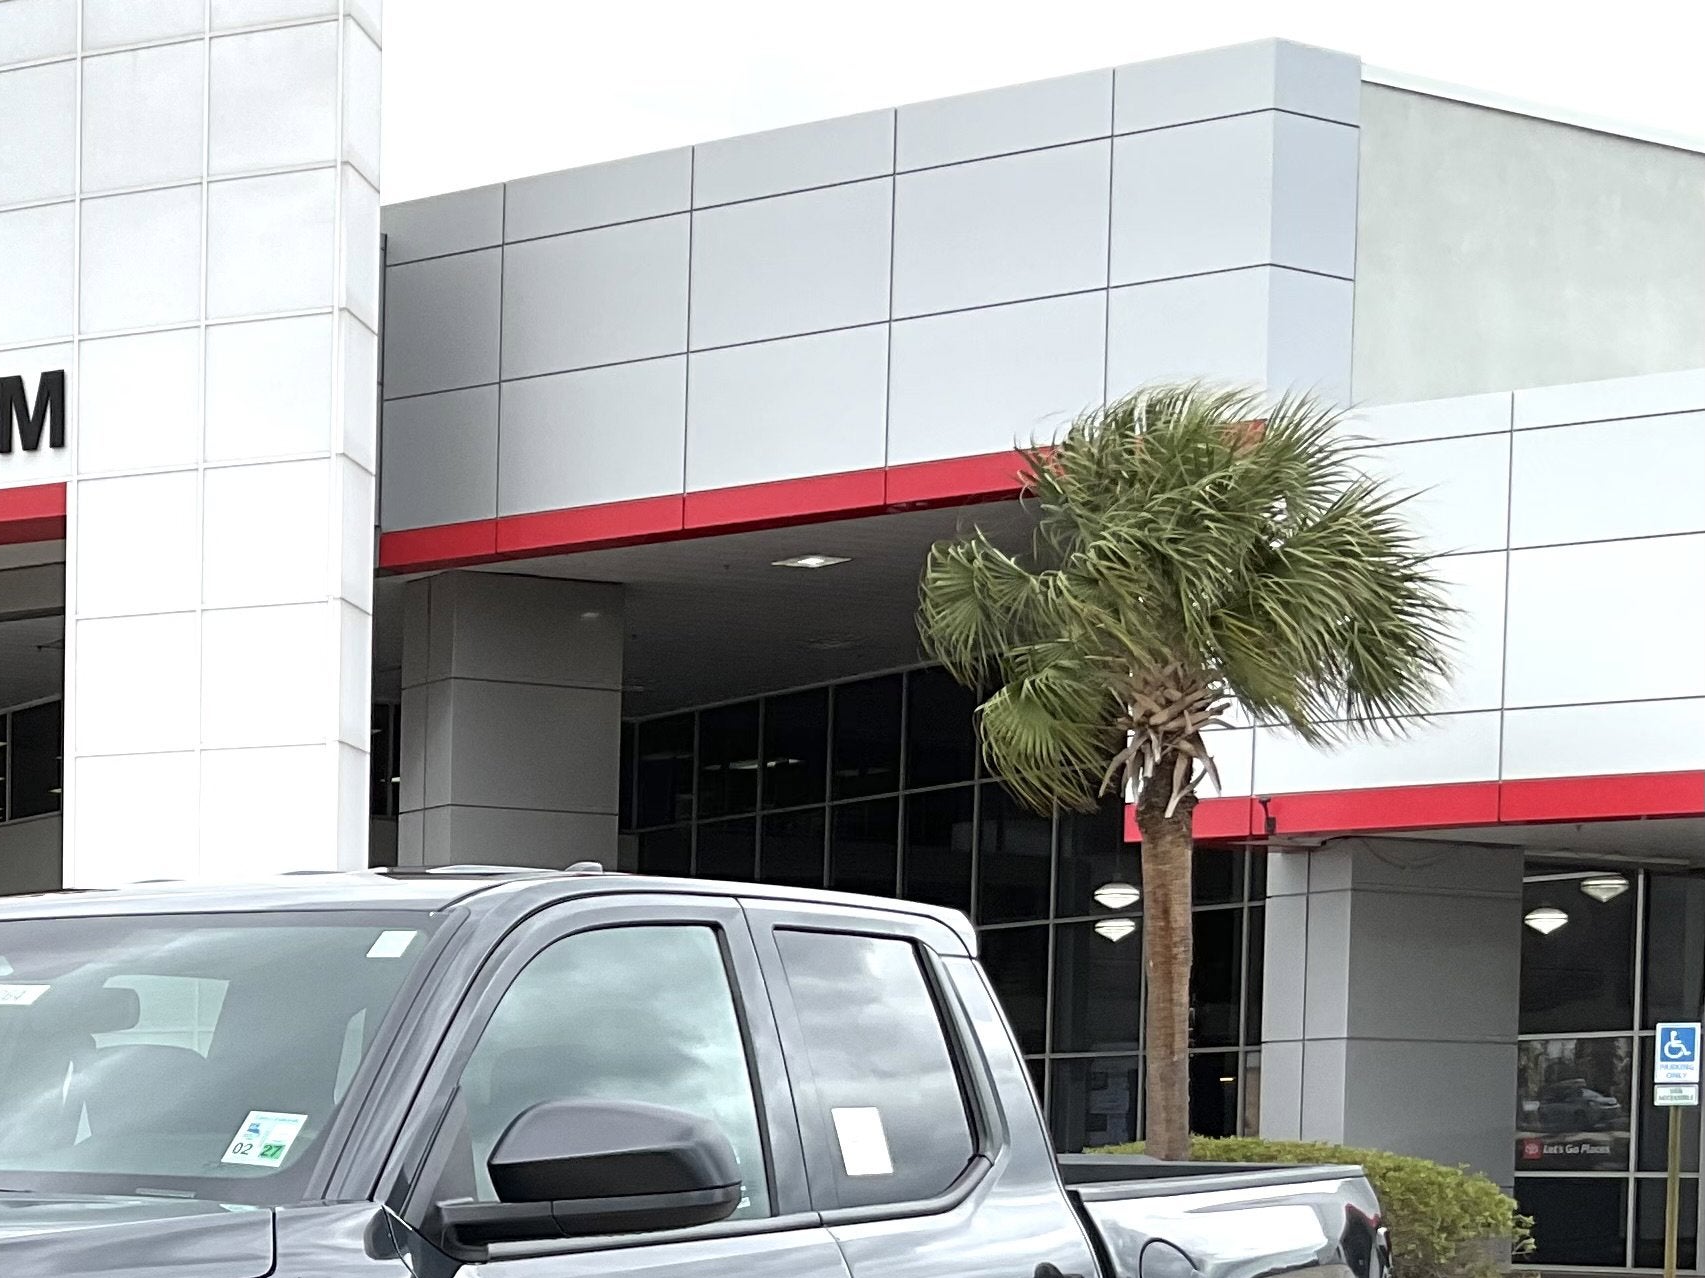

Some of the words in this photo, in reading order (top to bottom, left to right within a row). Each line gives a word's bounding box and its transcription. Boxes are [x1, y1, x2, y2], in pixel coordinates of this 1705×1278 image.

[232, 1142, 254, 1156] 02
[260, 1143, 286, 1158] 27
[1565, 1144, 1580, 1154] Go
